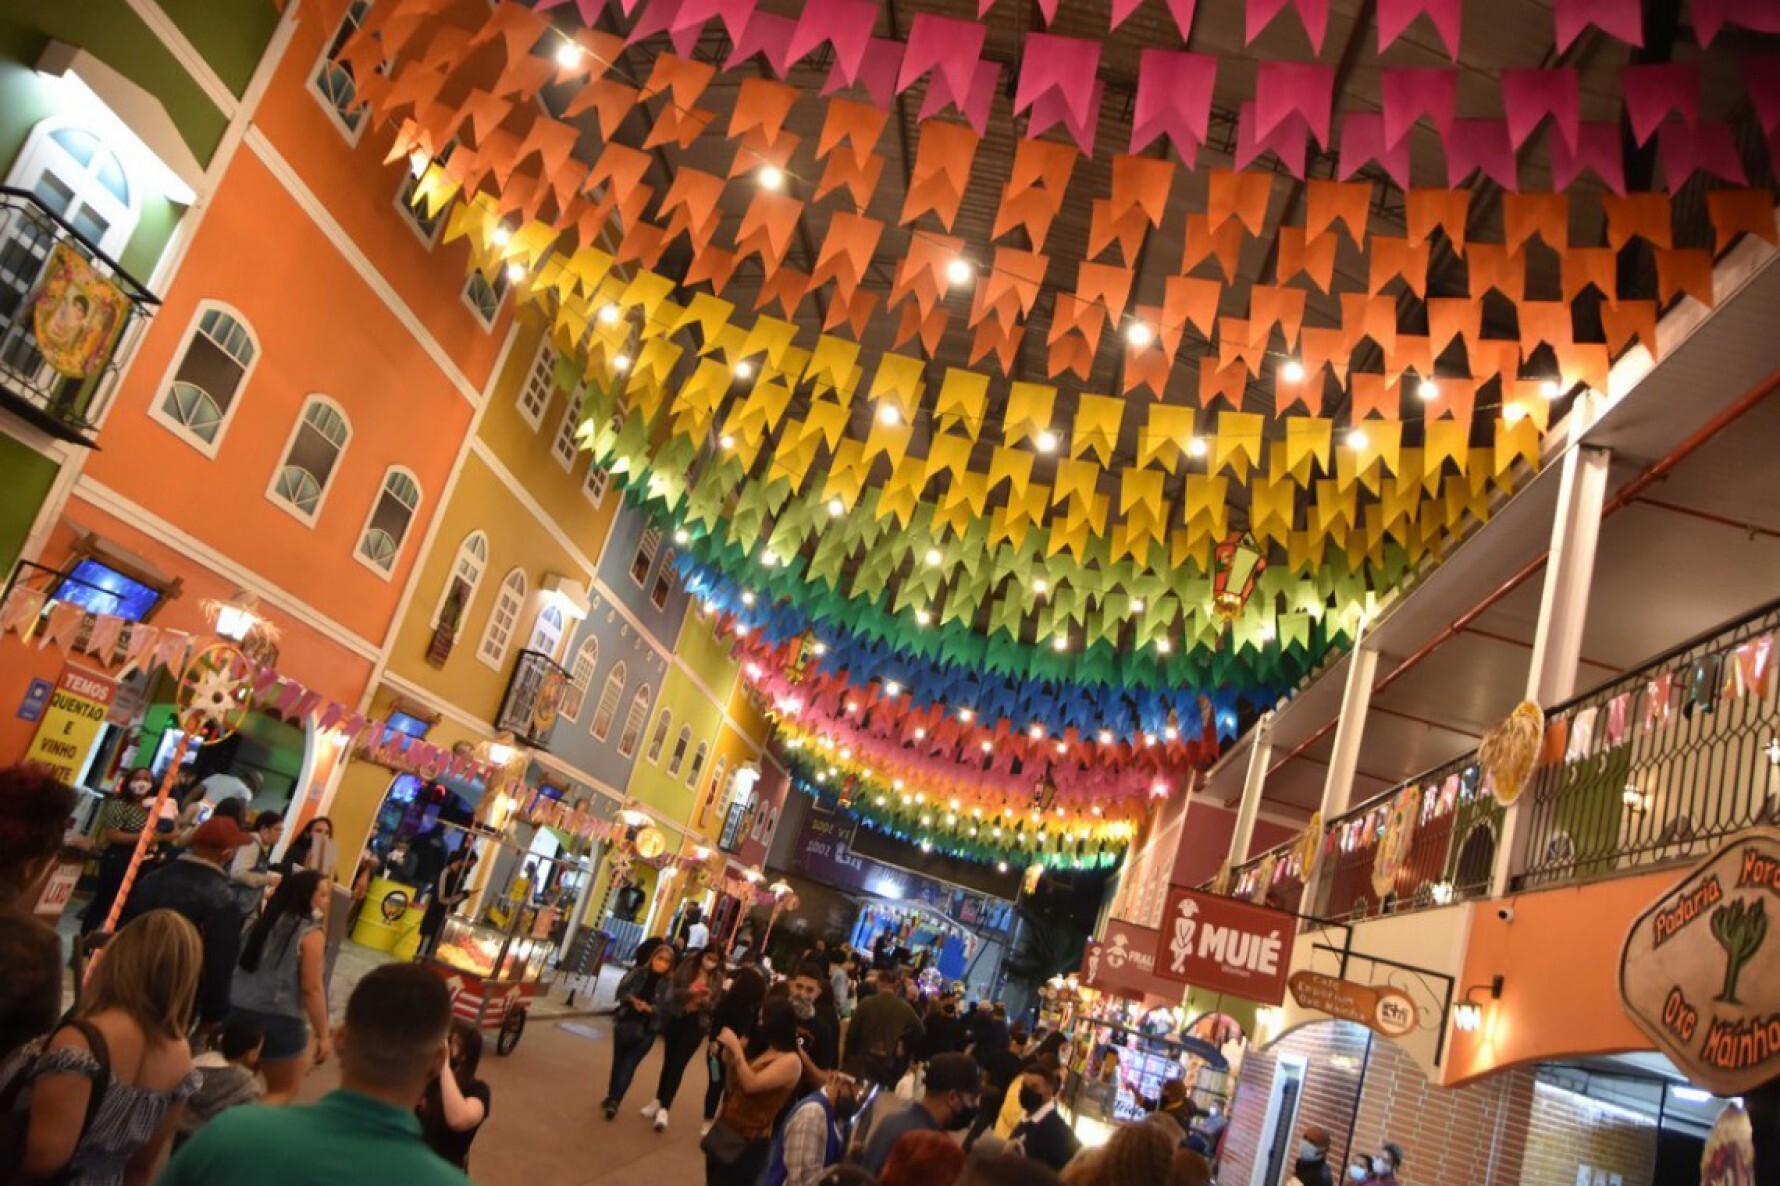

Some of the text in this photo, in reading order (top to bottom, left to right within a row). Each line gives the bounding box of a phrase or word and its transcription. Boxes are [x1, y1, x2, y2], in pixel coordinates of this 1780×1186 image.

[65, 673, 110, 700] TEMOS
[63, 720, 73, 735] E
[41, 737, 77, 759] VINHO
[1656, 877, 1722, 944] Padaria
[1198, 922, 1282, 976] MUIÉ
[1664, 990, 1695, 1041] Oxe
